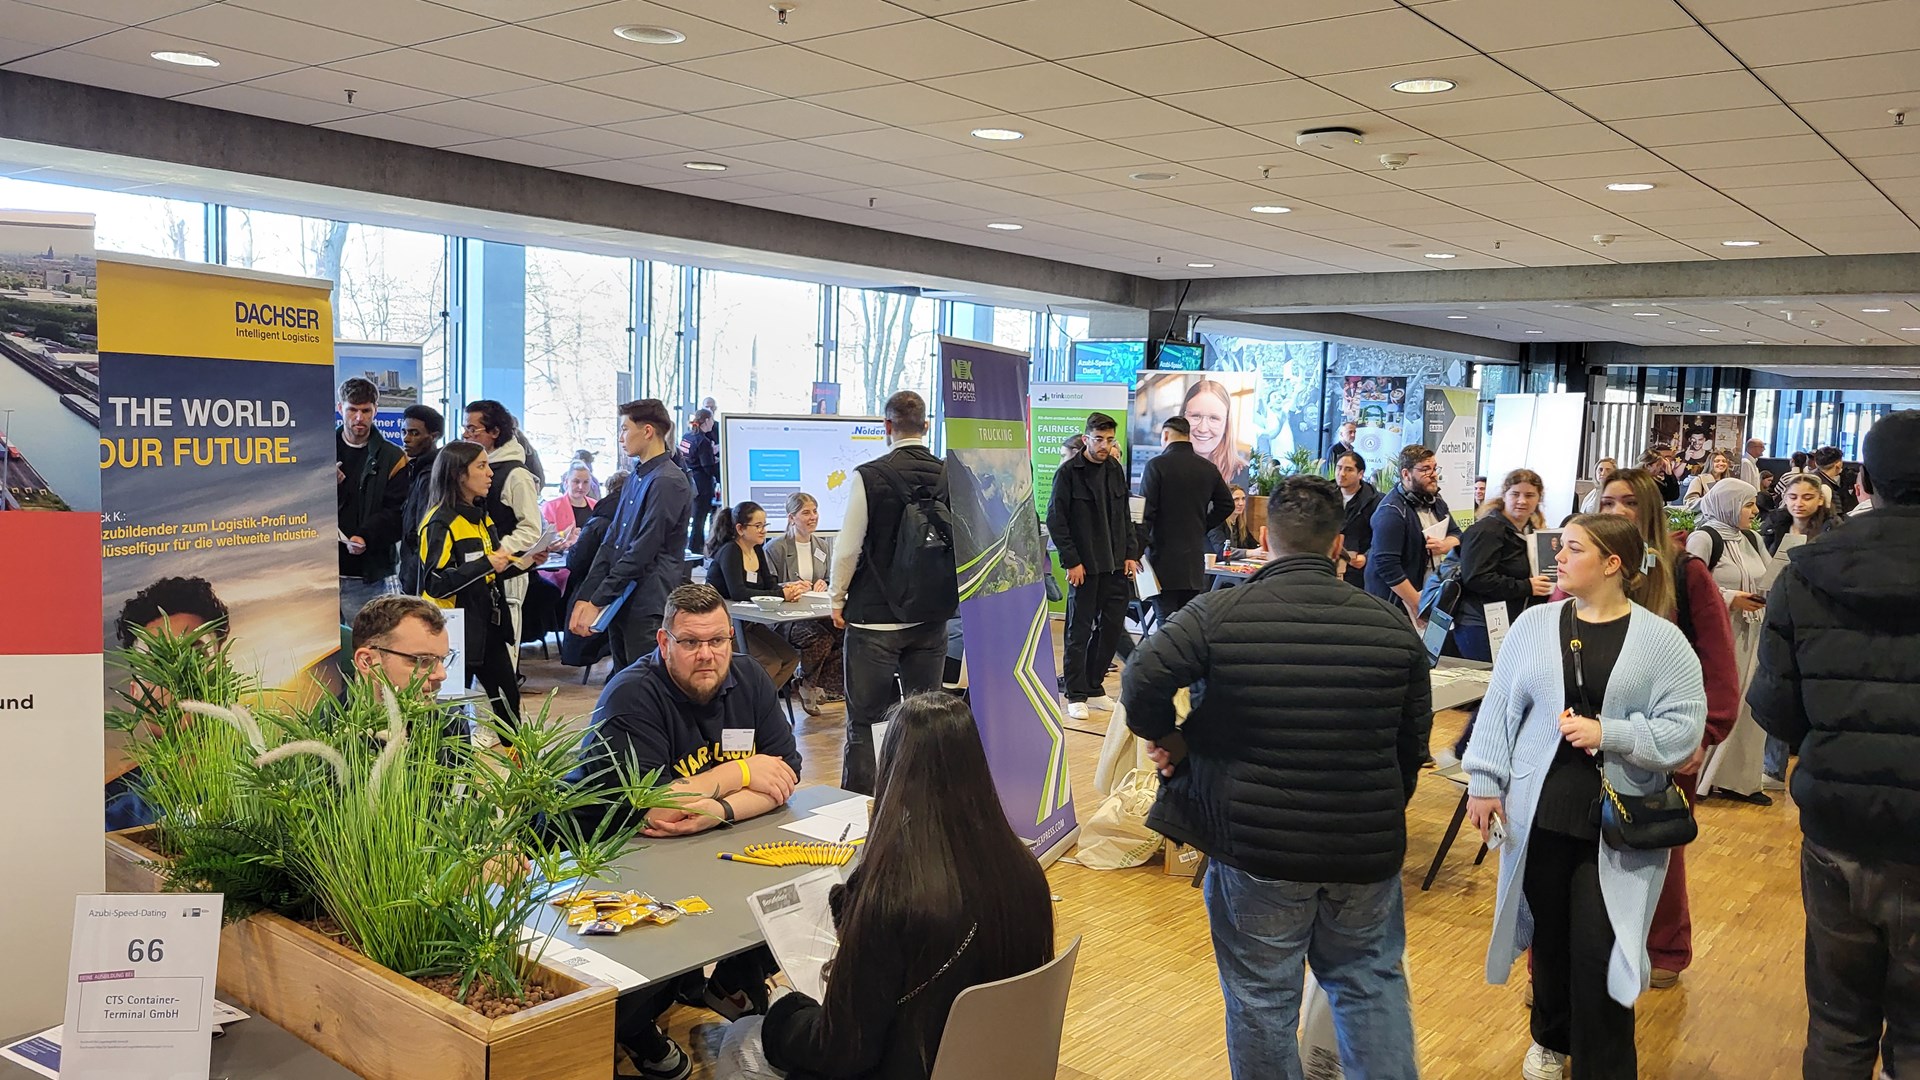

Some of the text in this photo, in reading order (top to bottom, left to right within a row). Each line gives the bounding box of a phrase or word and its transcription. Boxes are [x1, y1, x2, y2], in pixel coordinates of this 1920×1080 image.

[235, 301, 319, 330] DACHSER
[236, 327, 320, 343] Intelligent Logistics
[952, 381, 976, 392] NIPPON
[952, 391, 976, 402] EXPRESS
[108, 397, 296, 428] THE WORLD.
[855, 426, 886, 435] Nolden
[979, 427, 1013, 441] TRUCKING
[173, 437, 297, 466] FUTURE.
[1441, 442, 1461, 453] suchen
[102, 512, 307, 540] zubildender zum Logistik-Profi und
[172, 537, 191, 551] für
[194, 535, 213, 549] die
[216, 532, 270, 547] weltweite
[273, 527, 320, 542] Industrie.
[88, 908, 167, 918] Azubi-Speed-Dating
[127, 938, 165, 963] 66
[105, 995, 181, 1005] CTS Container-
[104, 1009, 179, 1019] Terminal GmbH
